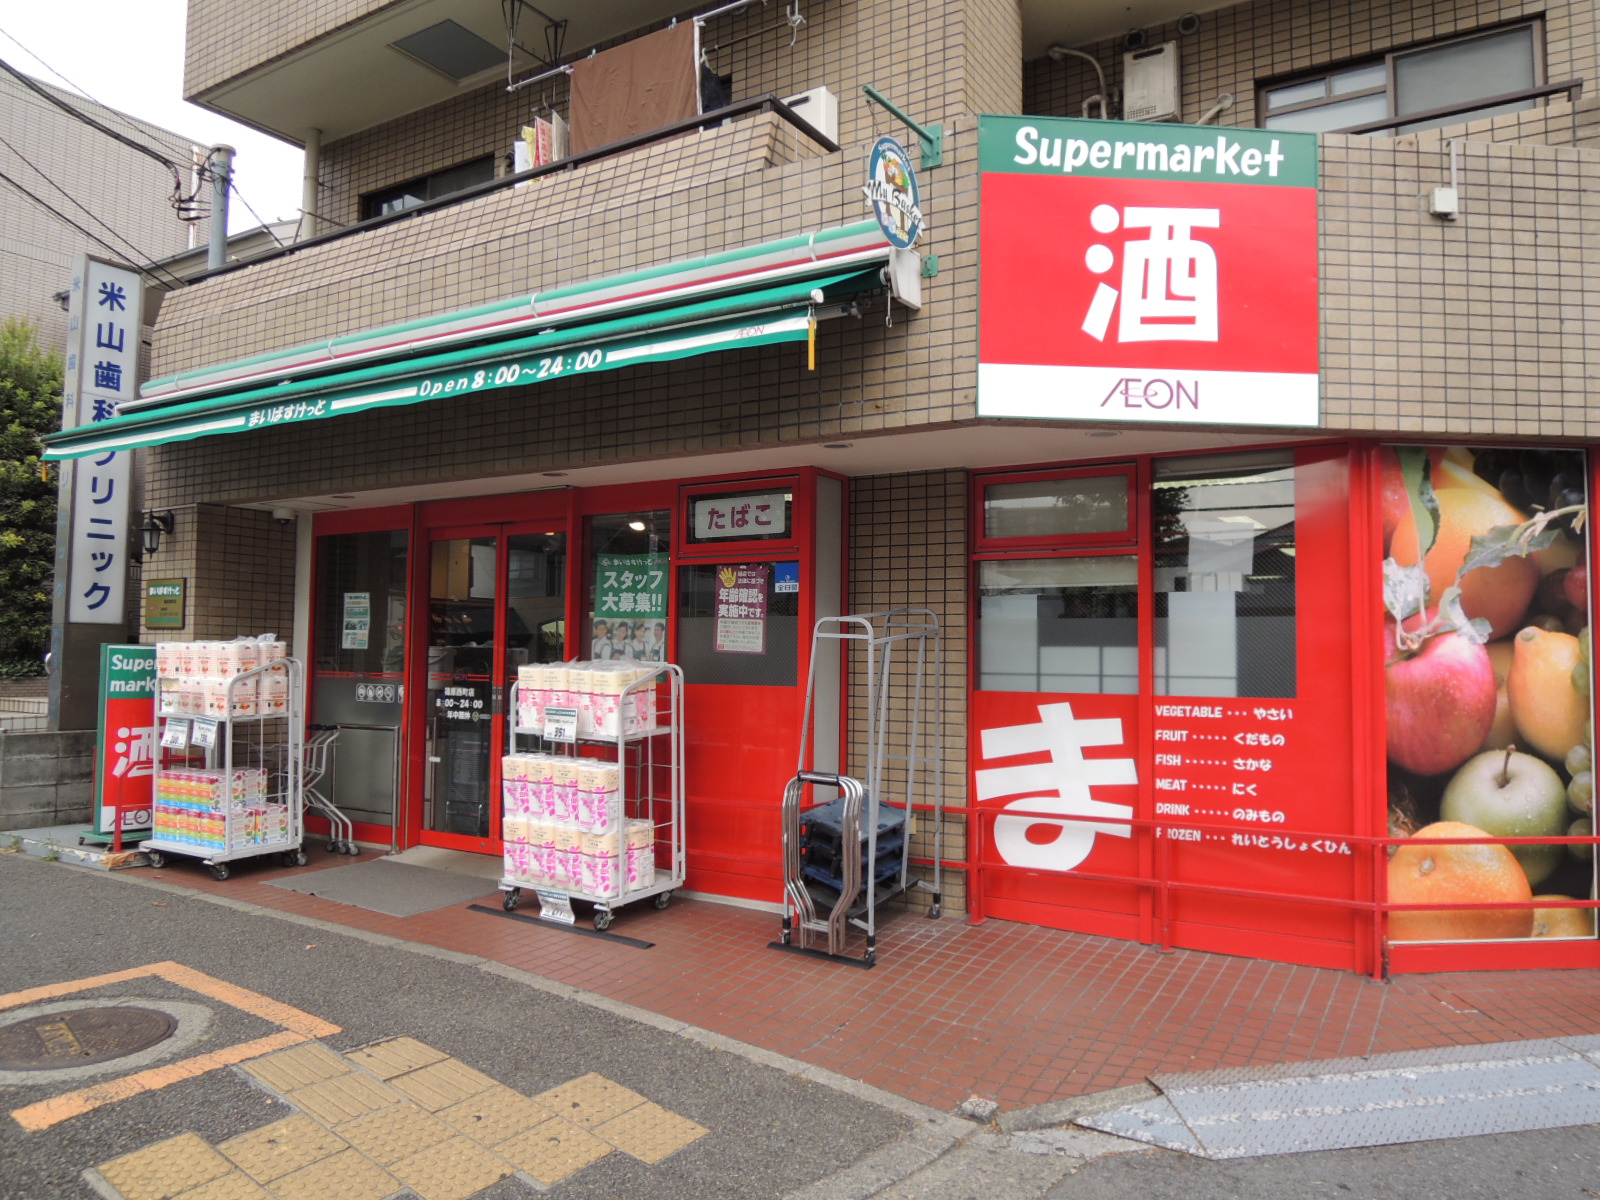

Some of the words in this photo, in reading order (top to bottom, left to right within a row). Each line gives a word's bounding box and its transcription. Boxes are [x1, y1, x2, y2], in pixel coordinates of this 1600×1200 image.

[1014, 126, 1284, 177] Supermarket
[867, 180, 888, 201] My
[891, 188, 922, 226] Basket
[1081, 204, 1220, 343] 酒
[419, 377, 469, 397] Open
[248, 399, 328, 428] まいばすけっと
[707, 503, 772, 530] たばこ
[602, 570, 663, 590] スタッフ
[601, 591, 662, 613] 大募集!!
[718, 587, 764, 604] 年齢確認を
[717, 603, 764, 618] 実施中です。
[1155, 705, 1223, 718] VEGETABLE
[1253, 707, 1294, 721] やさい
[1155, 730, 1189, 742] FRUIT
[1233, 732, 1286, 747] くだもの
[1155, 754, 1182, 766] FISH
[1233, 757, 1273, 771] さかな
[975, 701, 1139, 871] ま
[1155, 778, 1188, 791] MEAT
[1232, 782, 1258, 796] にく
[1156, 802, 1190, 816] DRINK
[1232, 807, 1286, 824] のみもの
[1231, 833, 1352, 855] れいとうしょくひん
